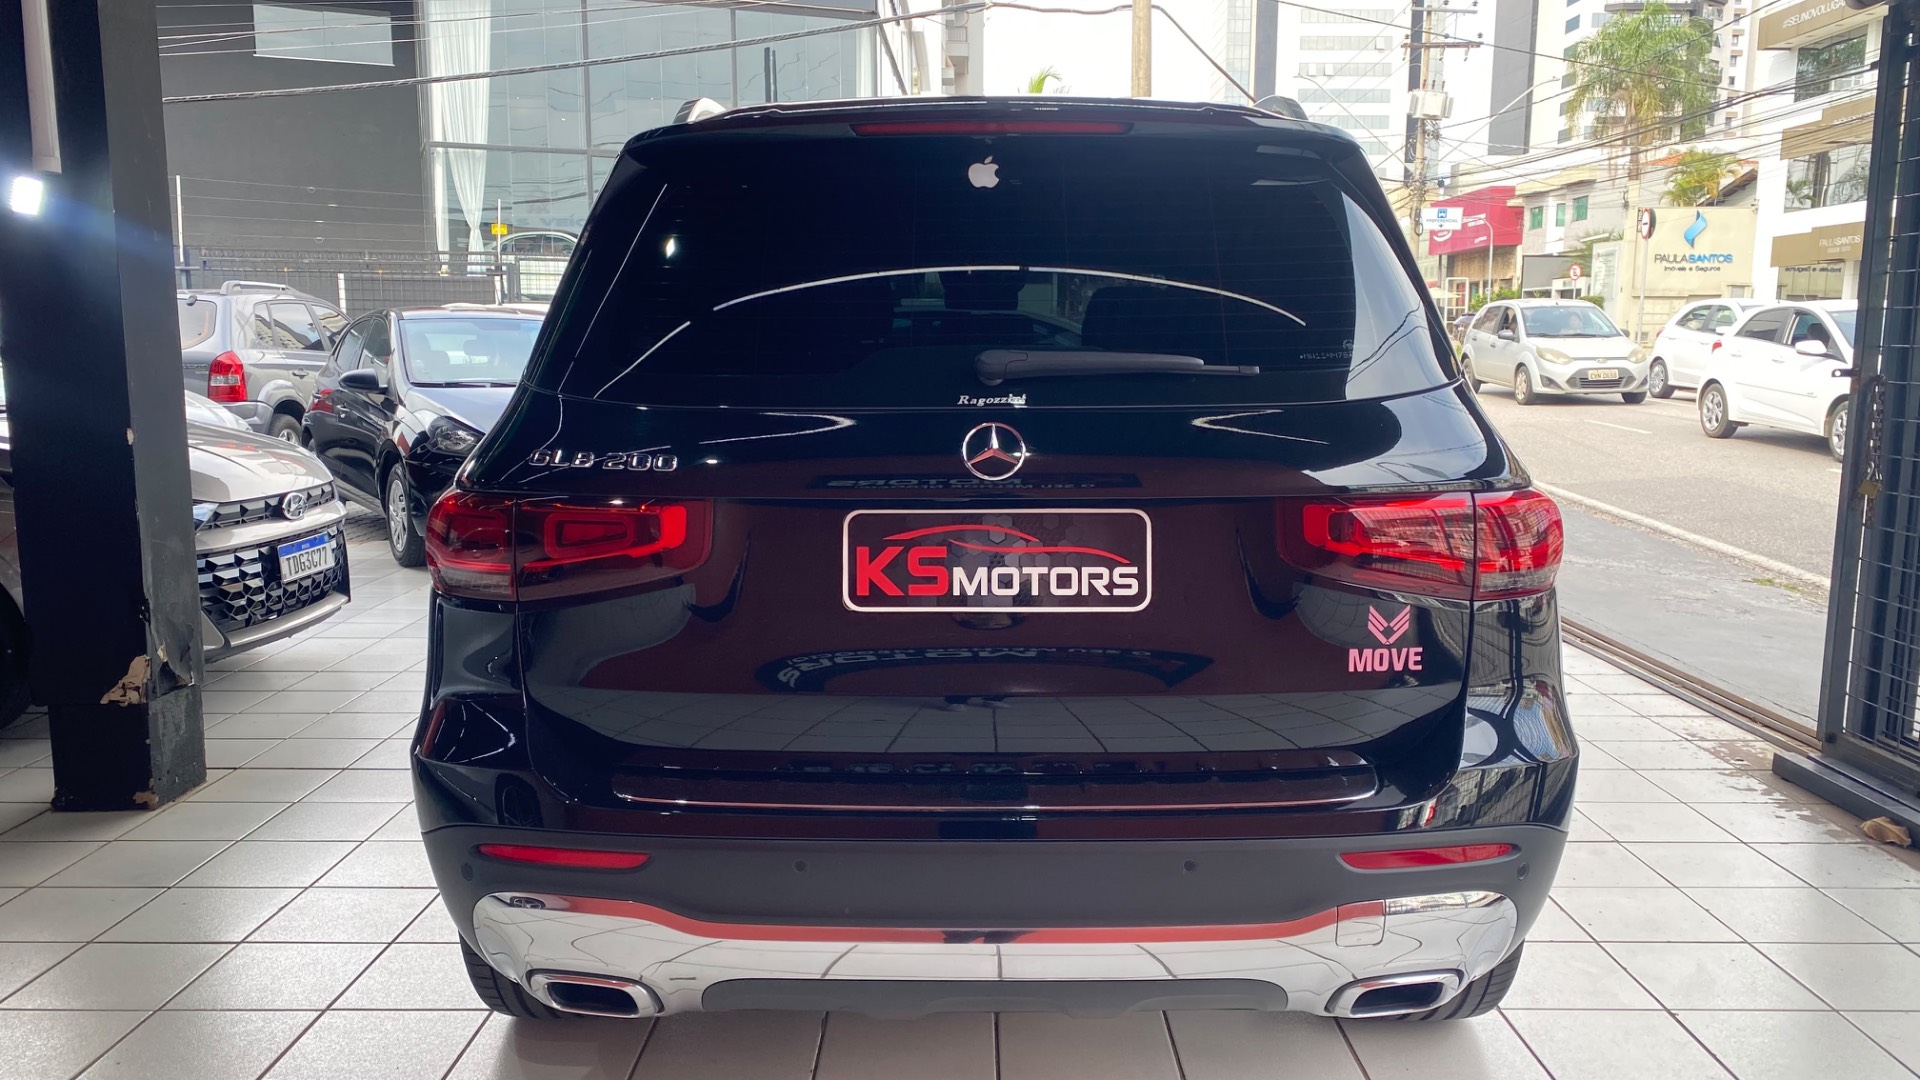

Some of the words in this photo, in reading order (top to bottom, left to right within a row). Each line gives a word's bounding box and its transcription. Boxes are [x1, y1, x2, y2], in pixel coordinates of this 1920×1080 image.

[1654, 253, 1734, 264] PAULASANTOS
[1695, 265, 1721, 273] Seguros
[529, 449, 595, 468] GLB
[602, 452, 678, 472] 200
[286, 546, 328, 576] TDG3C77
[1348, 647, 1423, 672] MOVE
